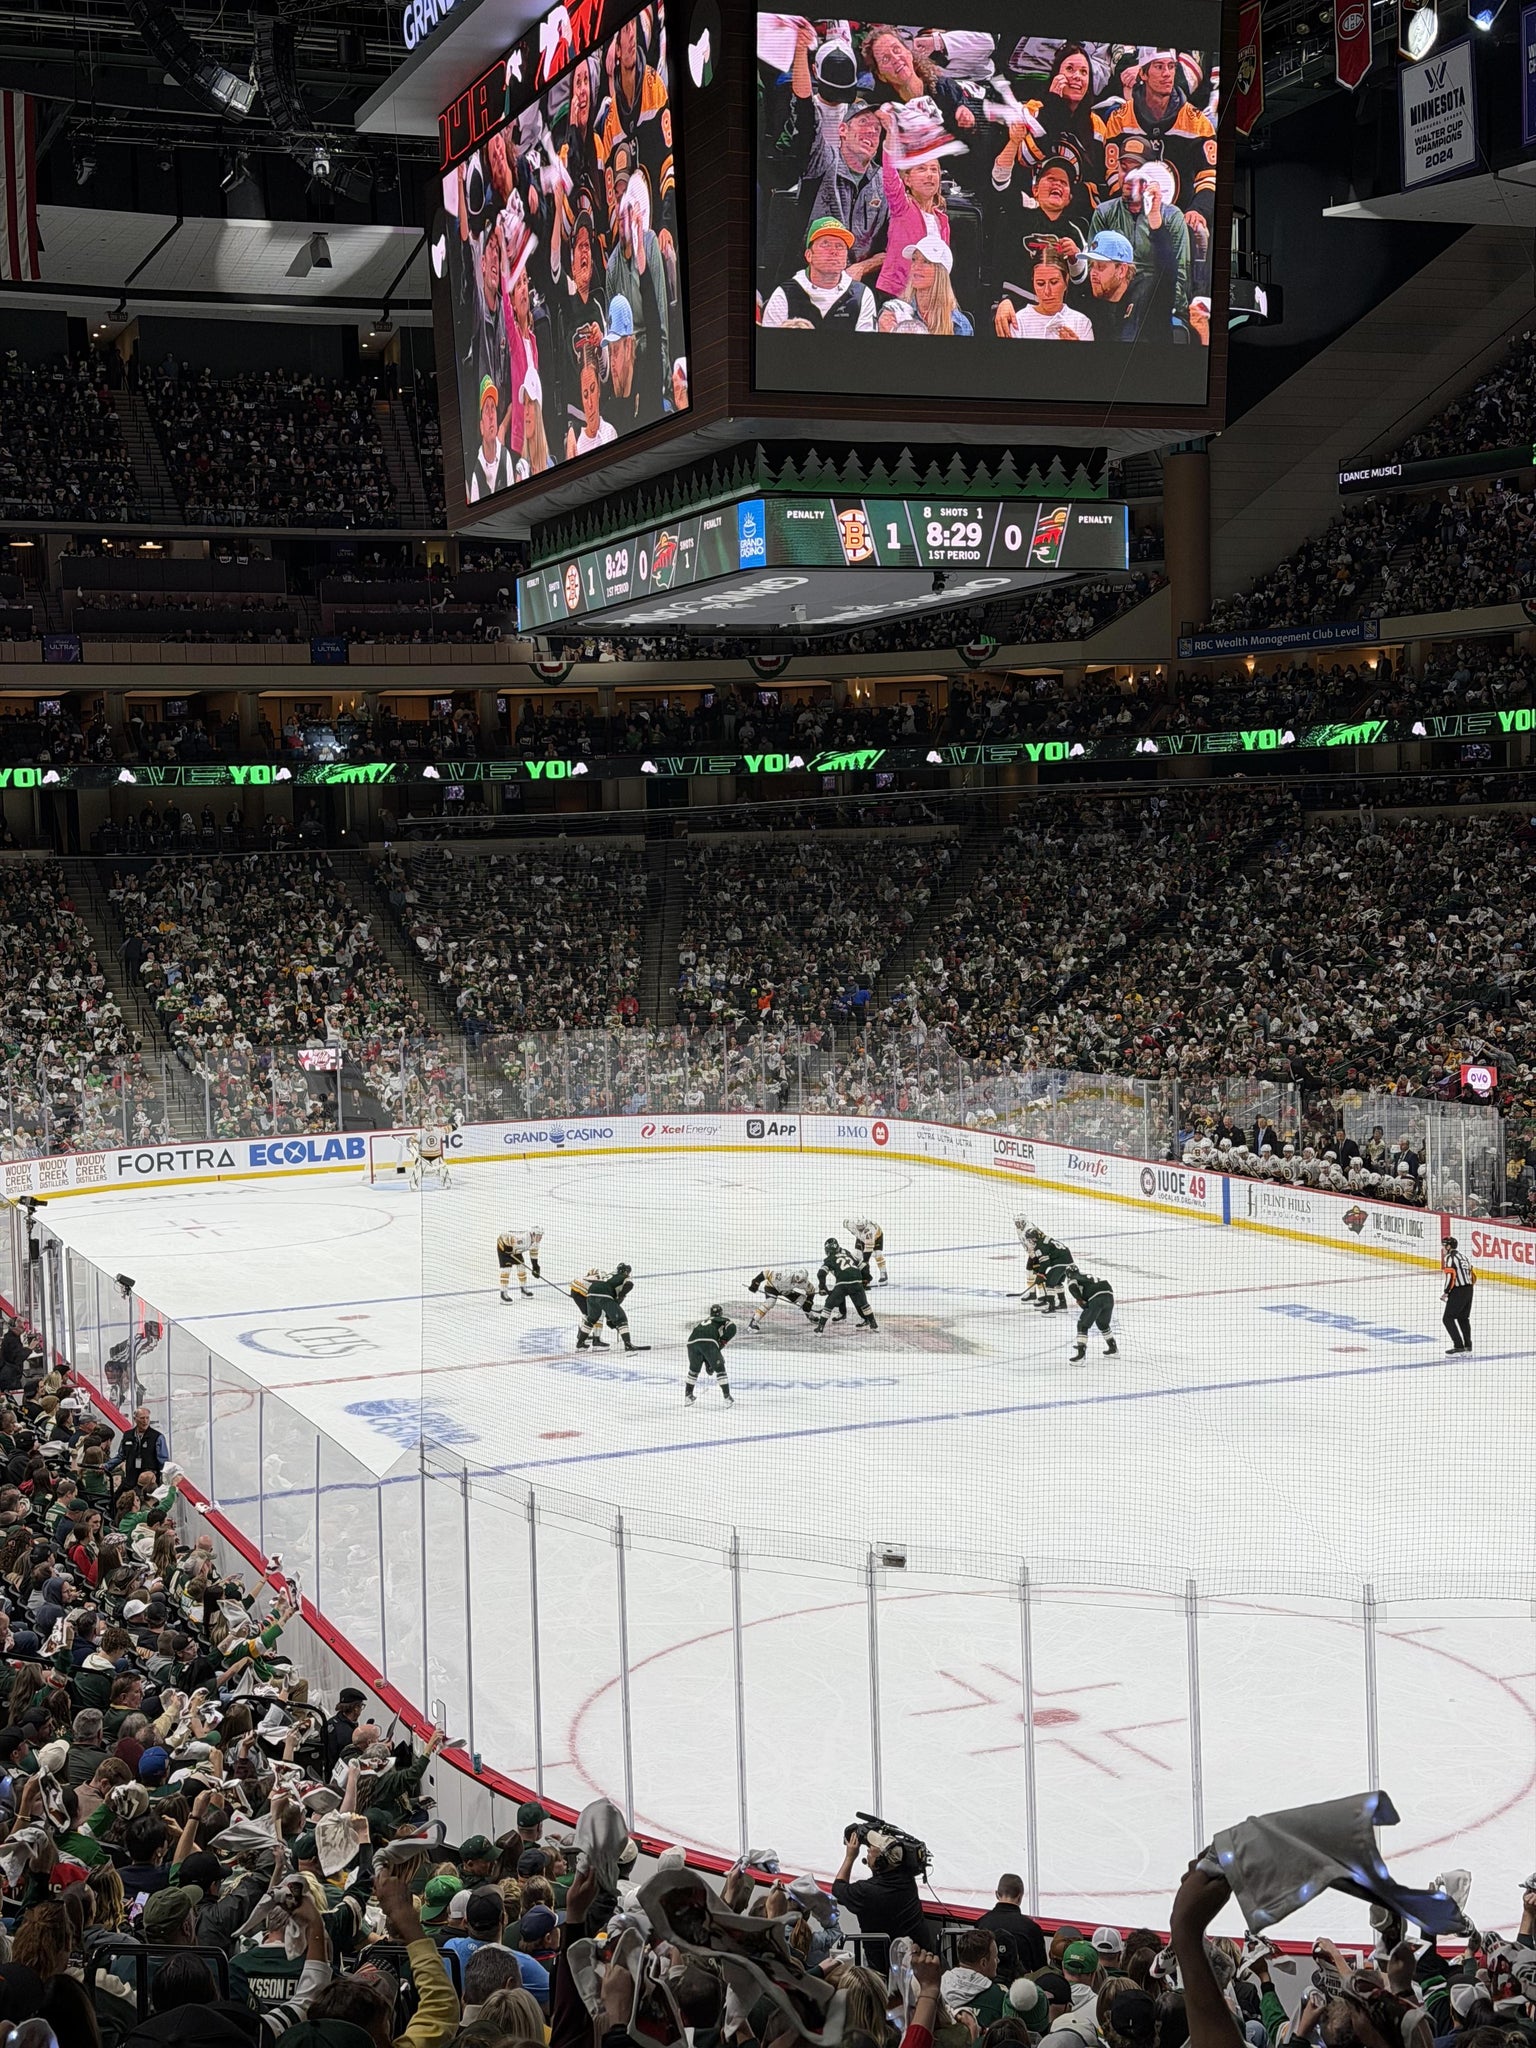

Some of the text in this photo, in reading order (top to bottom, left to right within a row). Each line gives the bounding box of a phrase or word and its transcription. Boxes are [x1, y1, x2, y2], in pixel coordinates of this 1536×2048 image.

[1410, 86, 1465, 126] MINNESOTA
[1414, 120, 1464, 147] WALTER CUP
[1416, 131, 1462, 155] CHAMPIONS
[1425, 148, 1454, 169] 2024
[786, 510, 825, 519] PENALTY
[923, 506, 984, 519] 8 SHOTS 1
[1078, 515, 1113, 524] PENALTY
[703, 516, 722, 531] PENALTY
[886, 522, 901, 549] 1
[926, 522, 983, 547] 8:29
[1004, 524, 1023, 551] 0
[680, 537, 695, 551] SHOTS
[740, 538, 764, 549] GRAND
[740, 547, 764, 558] CASINO
[928, 550, 981, 560] 1ST PERIOD
[605, 549, 629, 580] 8:29
[639, 550, 648, 581] 0
[685, 553, 690, 569] 1
[588, 567, 595, 597] 1
[606, 581, 629, 599] 1ST PERIOD
[1194, 640, 1213, 651] RBC
[1215, 637, 1248, 649] Wealth
[1250, 632, 1311, 647] Management
[1313, 629, 1333, 639] Club
[1335, 625, 1360, 638] Level
[1470, 1073, 1488, 1083] OVO
[504, 1127, 614, 1145] GRAND CASINO
[661, 1123, 718, 1137] Xcel Energy
[837, 1125, 868, 1138] BMO
[250, 1137, 366, 1167] ECOLAB
[994, 1138, 1034, 1160] LOFFLER
[39, 1159, 68, 1171] WOODY
[75, 1154, 106, 1167] WOODY
[118, 1148, 235, 1176] FORTRA
[1068, 1154, 1108, 1177] Bonfe
[6, 1164, 32, 1177] WOODY
[39, 1170, 68, 1182] CREEK
[76, 1164, 106, 1176] CREEK
[6, 1175, 32, 1188] CREEK
[40, 1178, 69, 1190] DISTILLERS
[76, 1173, 107, 1184] DISTILLERS
[1158, 1170, 1186, 1195] IUOE
[1189, 1175, 1206, 1199] 49
[6, 1184, 33, 1195] DISTILLERS
[1263, 1193, 1311, 1213] FLINT HILLS
[1372, 1212, 1424, 1239] THE HOCKEY LODGE
[1471, 1231, 1536, 1266] SEATGE
[836, 1257, 860, 1271] 22
